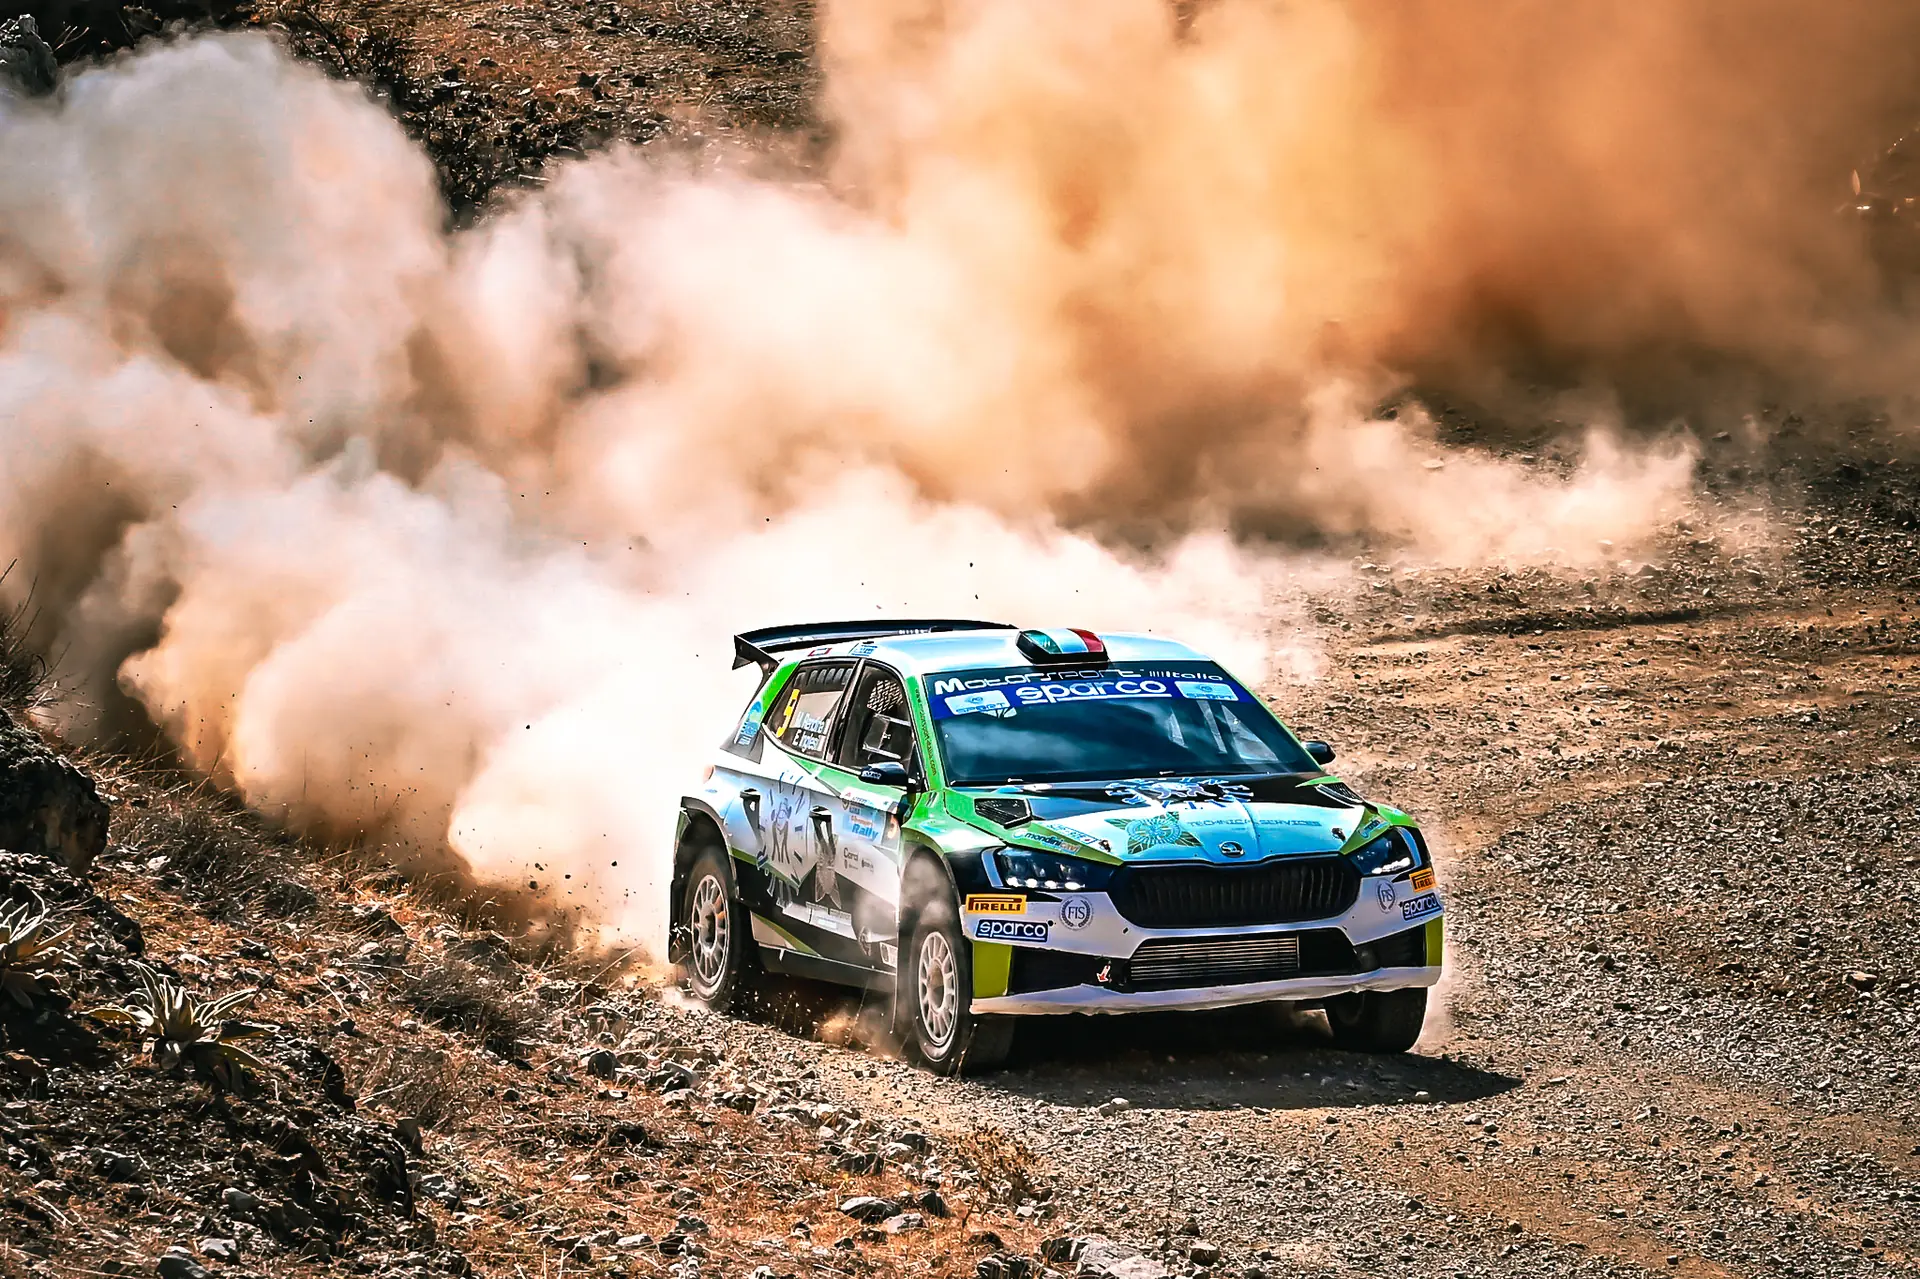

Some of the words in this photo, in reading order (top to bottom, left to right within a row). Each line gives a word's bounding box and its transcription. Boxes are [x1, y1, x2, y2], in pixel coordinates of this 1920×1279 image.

[1015, 680, 1173, 705] sparco
[851, 823, 879, 842] Rally
[967, 897, 1023, 911] PIRELLI
[1067, 906, 1086, 919] FIS
[977, 921, 1046, 941] sparco
